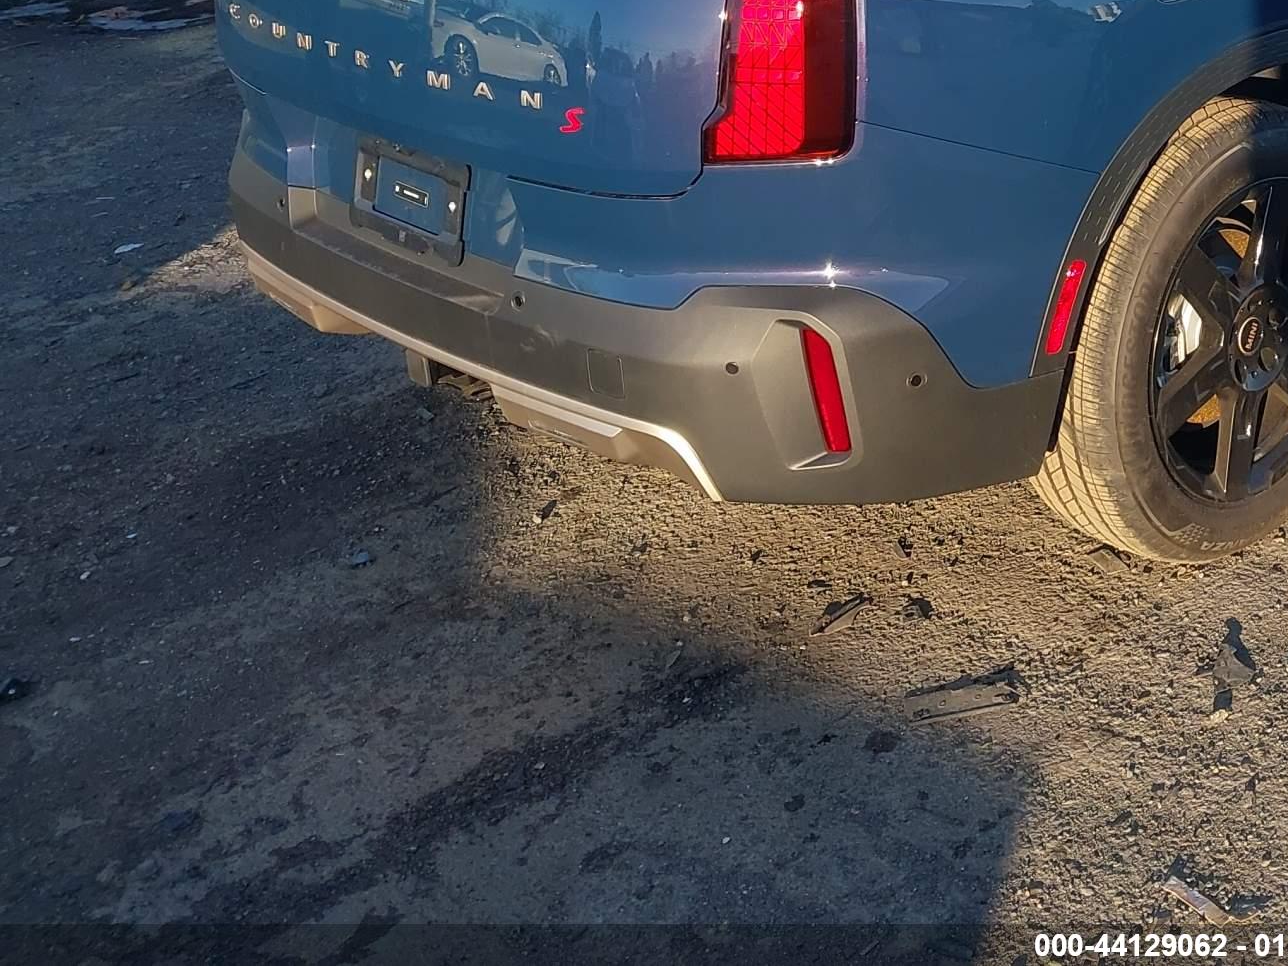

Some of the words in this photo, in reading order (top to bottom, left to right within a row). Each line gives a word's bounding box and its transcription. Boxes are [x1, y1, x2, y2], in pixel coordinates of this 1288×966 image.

[228, 3, 543, 110] COUNTRYMAN
[559, 107, 586, 133] S
[1245, 322, 1259, 349] MINI
